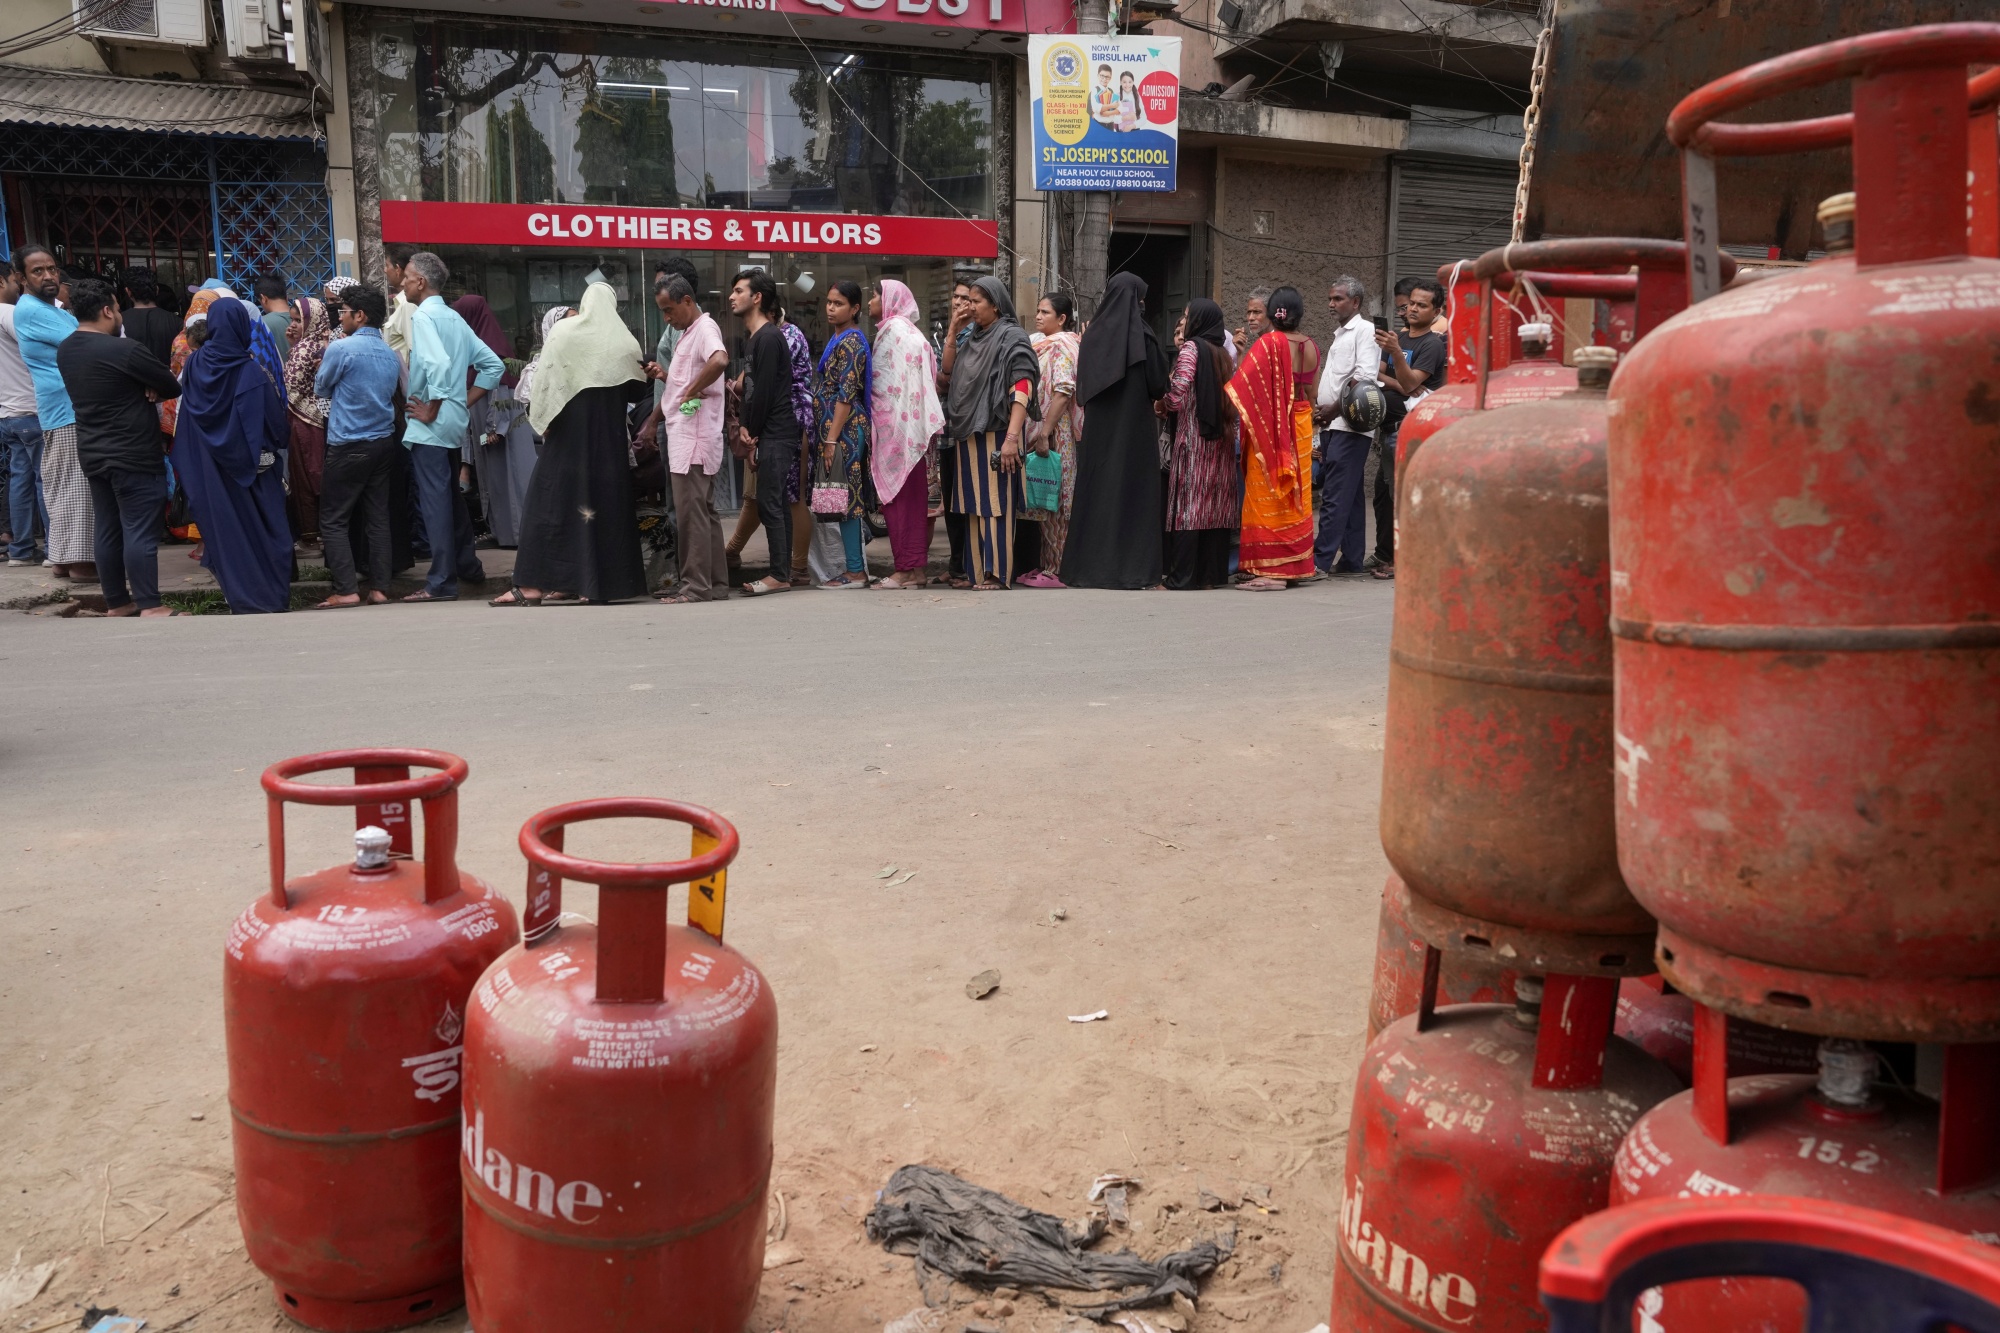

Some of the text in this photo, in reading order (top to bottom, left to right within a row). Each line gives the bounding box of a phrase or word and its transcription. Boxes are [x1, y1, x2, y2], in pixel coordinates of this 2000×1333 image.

[1091, 53, 1147, 62] BIRSUL HAAT
[1142, 84, 1175, 97] ADMISSION
[1150, 98, 1166, 111] OPEN
[1120, 148, 1169, 164] SCHOOL
[1056, 168, 1155, 178] NEAR HOLY CHILD SCHOOL
[1054, 178, 1082, 186] 90389
[1083, 179, 1111, 187] 00403
[1116, 179, 1140, 187] 89810
[1141, 180, 1166, 188] 04132
[527, 213, 882, 245] CLOTHIERS & TAILORS
[316, 904, 368, 923] 15.7
[539, 952, 580, 981] 15.4
[680, 952, 716, 982] 15.4
[588, 1040, 631, 1050] SWITCH
[588, 1049, 655, 1059] REGULATOR
[572, 1055, 670, 1069] WHEN NOT IN USE
[1798, 1136, 1881, 1174] 15.2
